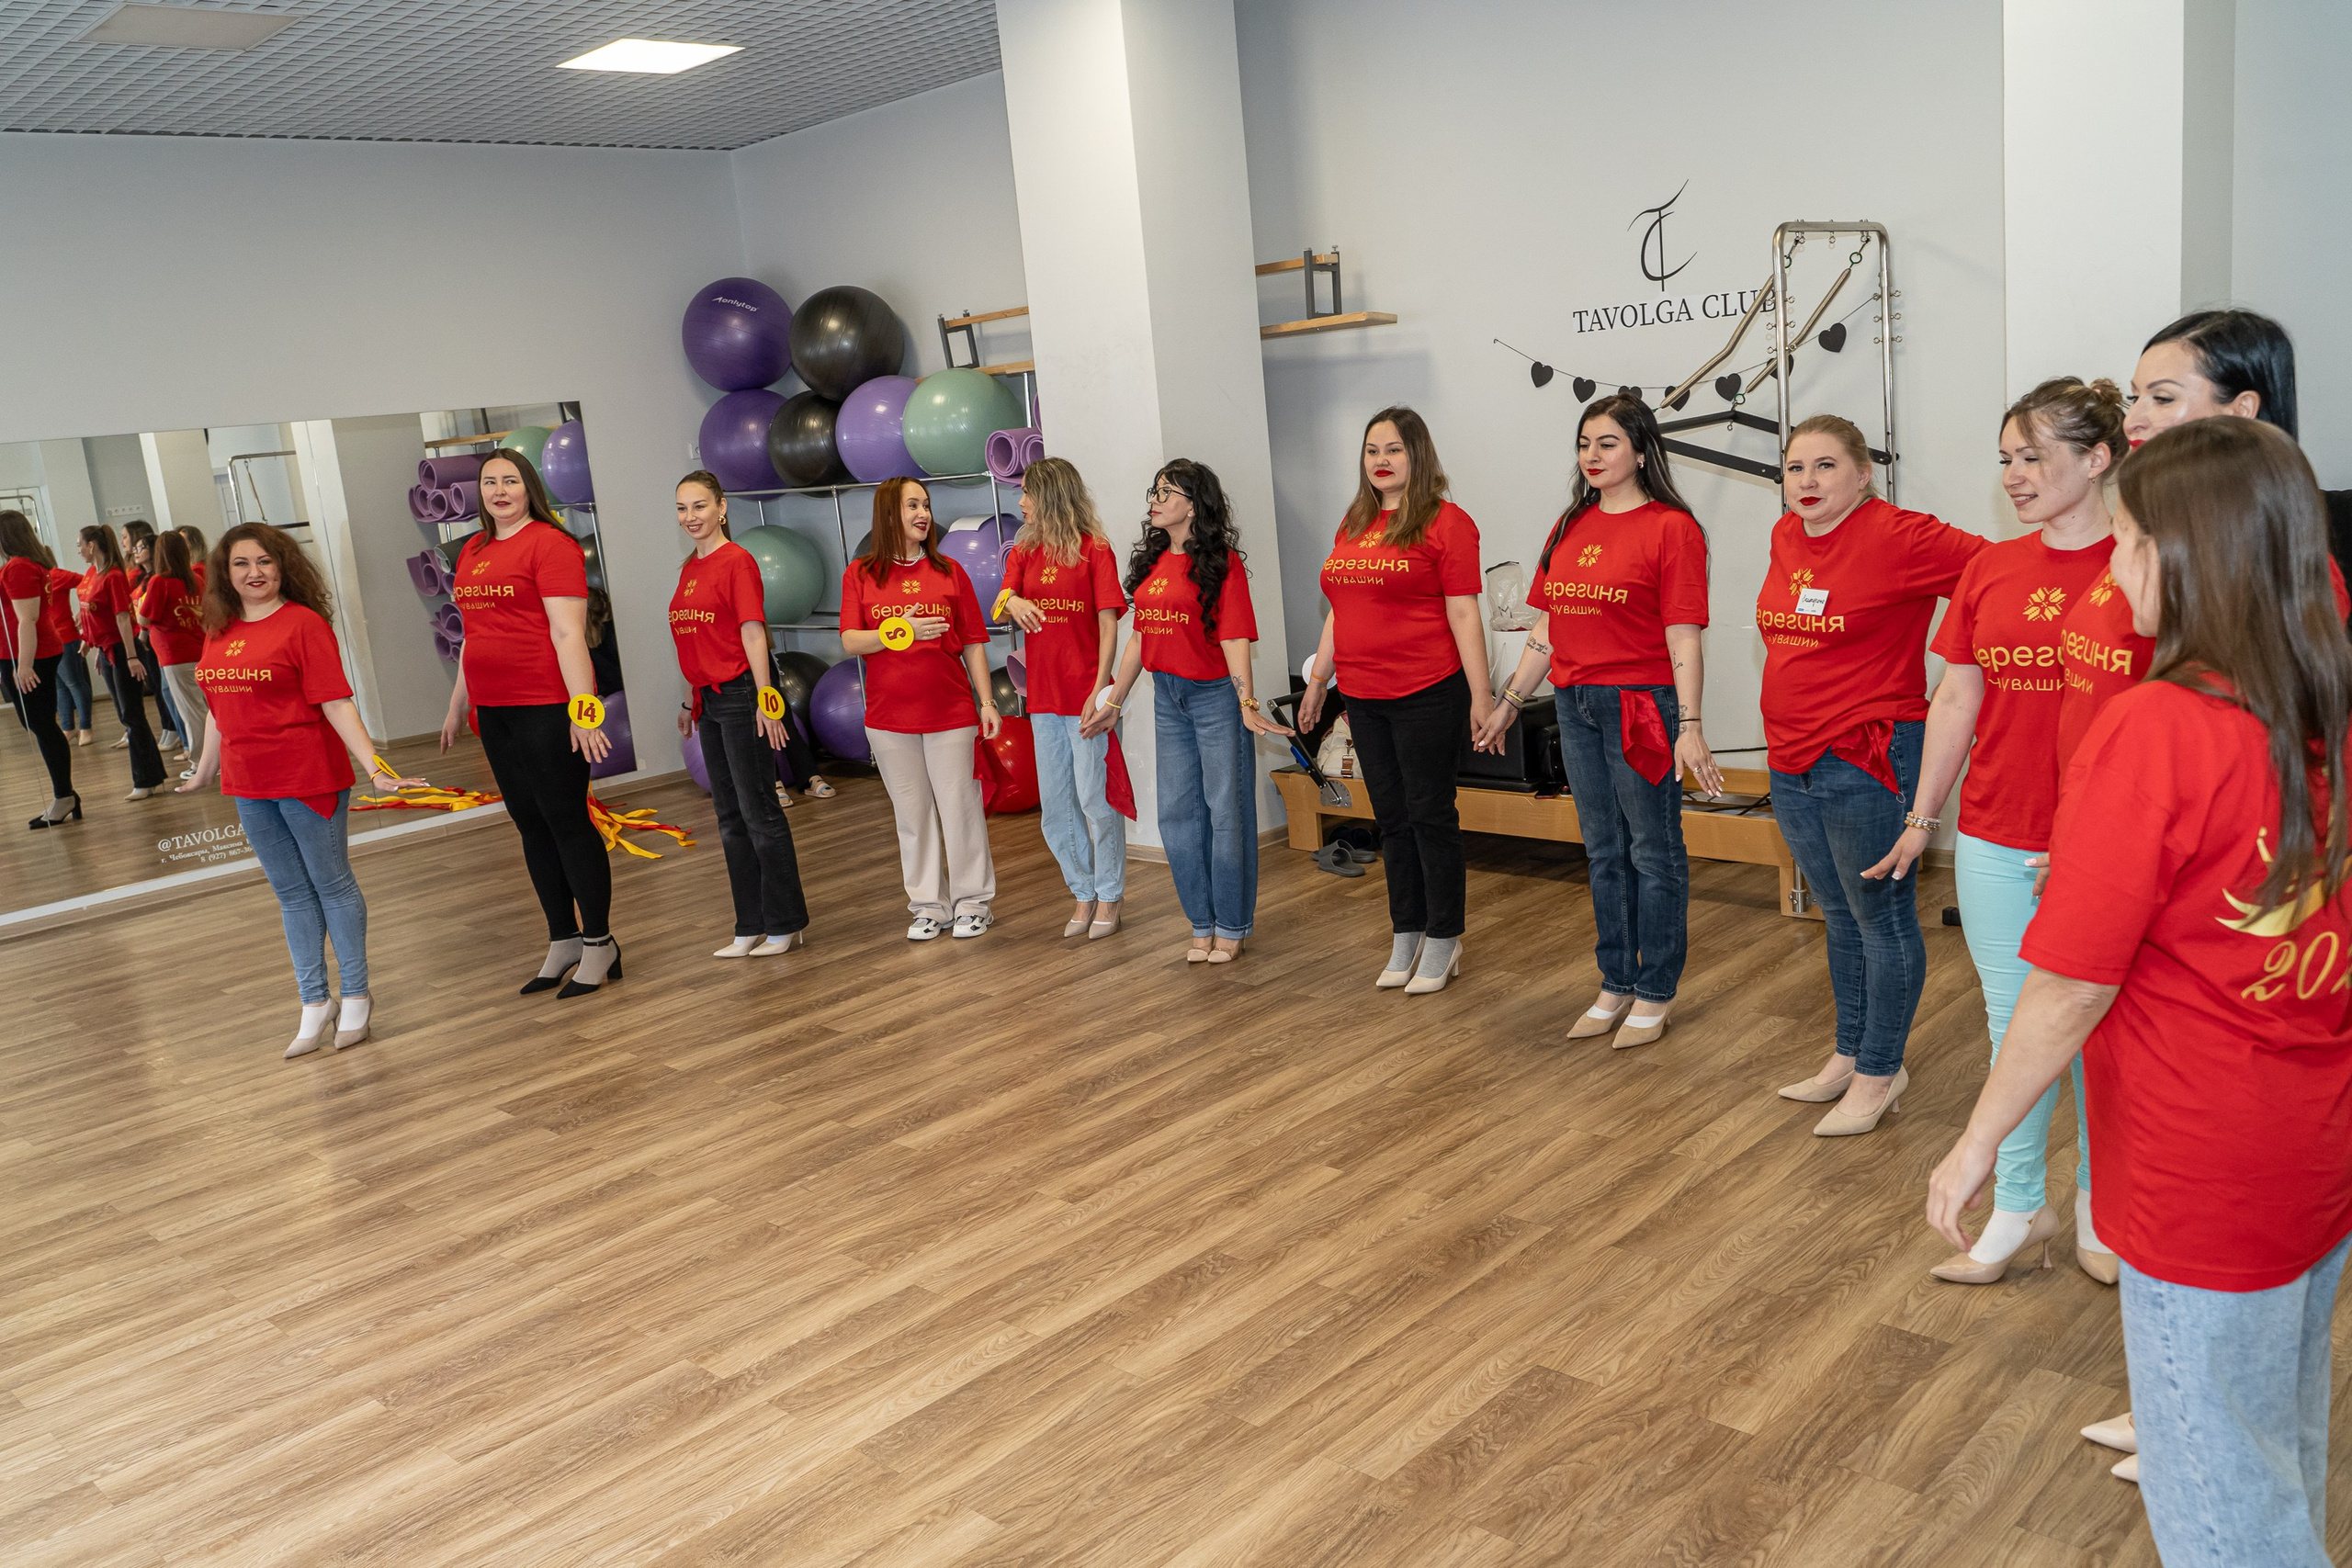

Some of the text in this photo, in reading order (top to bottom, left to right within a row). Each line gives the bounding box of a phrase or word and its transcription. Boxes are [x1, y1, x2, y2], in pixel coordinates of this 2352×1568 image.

[1572, 298, 1694, 333] TAVOLGA
[1323, 558, 1410, 574] ерегиня
[1327, 575, 1384, 586] чувашии
[1544, 581, 1629, 604] ерегиня
[1548, 604, 1603, 616] чувашии
[885, 627, 907, 641] 5
[195, 666, 272, 684] ерегиня
[205, 684, 253, 694] чувашии
[577, 700, 597, 723] 14
[763, 692, 779, 714] 10
